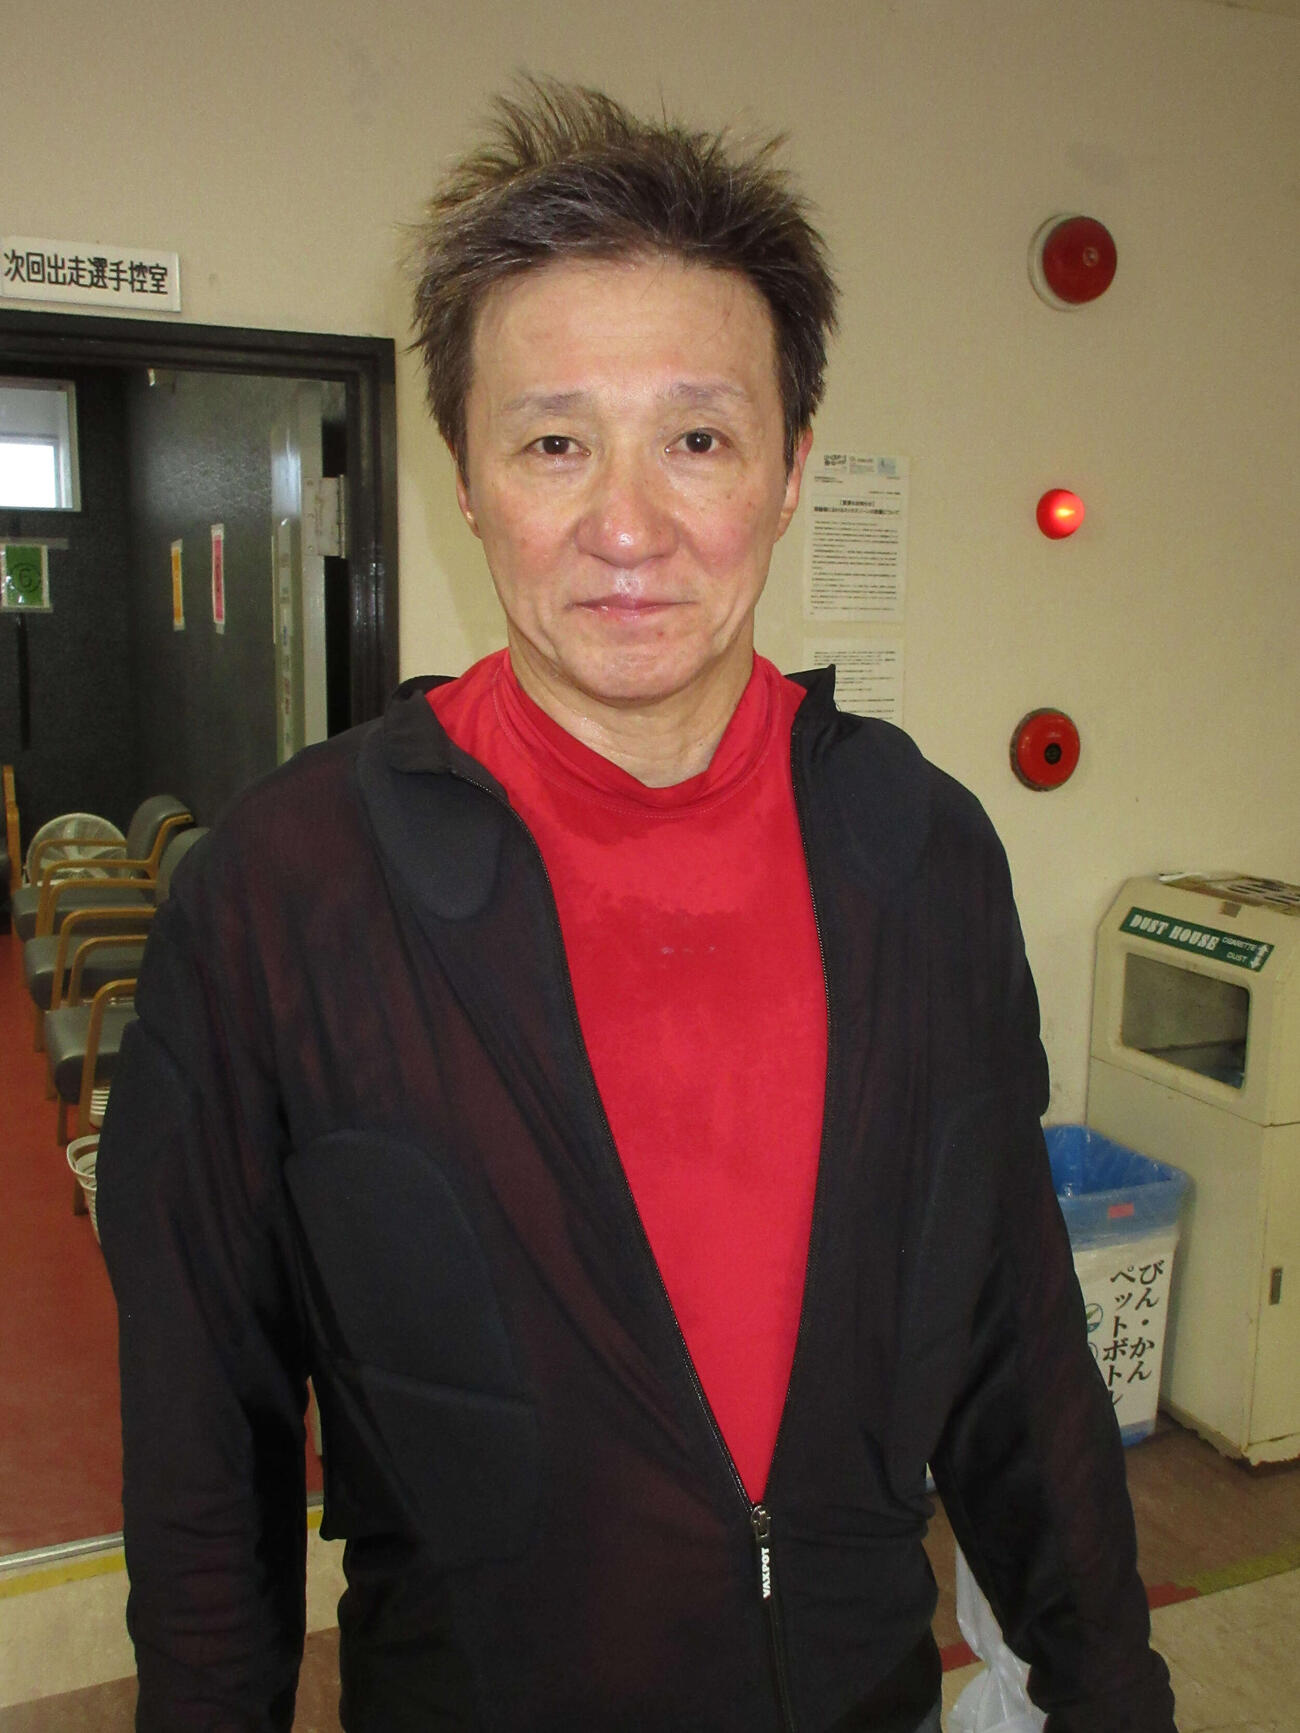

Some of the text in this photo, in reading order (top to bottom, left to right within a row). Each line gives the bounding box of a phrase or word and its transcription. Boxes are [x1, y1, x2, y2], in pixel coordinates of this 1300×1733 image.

[4, 249, 168, 294] 次回出走選手控室
[1130, 915, 1220, 951] DUST HOUSE
[1226, 952, 1249, 963] DUST
[1127, 1261, 1165, 1383] びん・かん
[761, 1547, 771, 1599] VAXPOT
